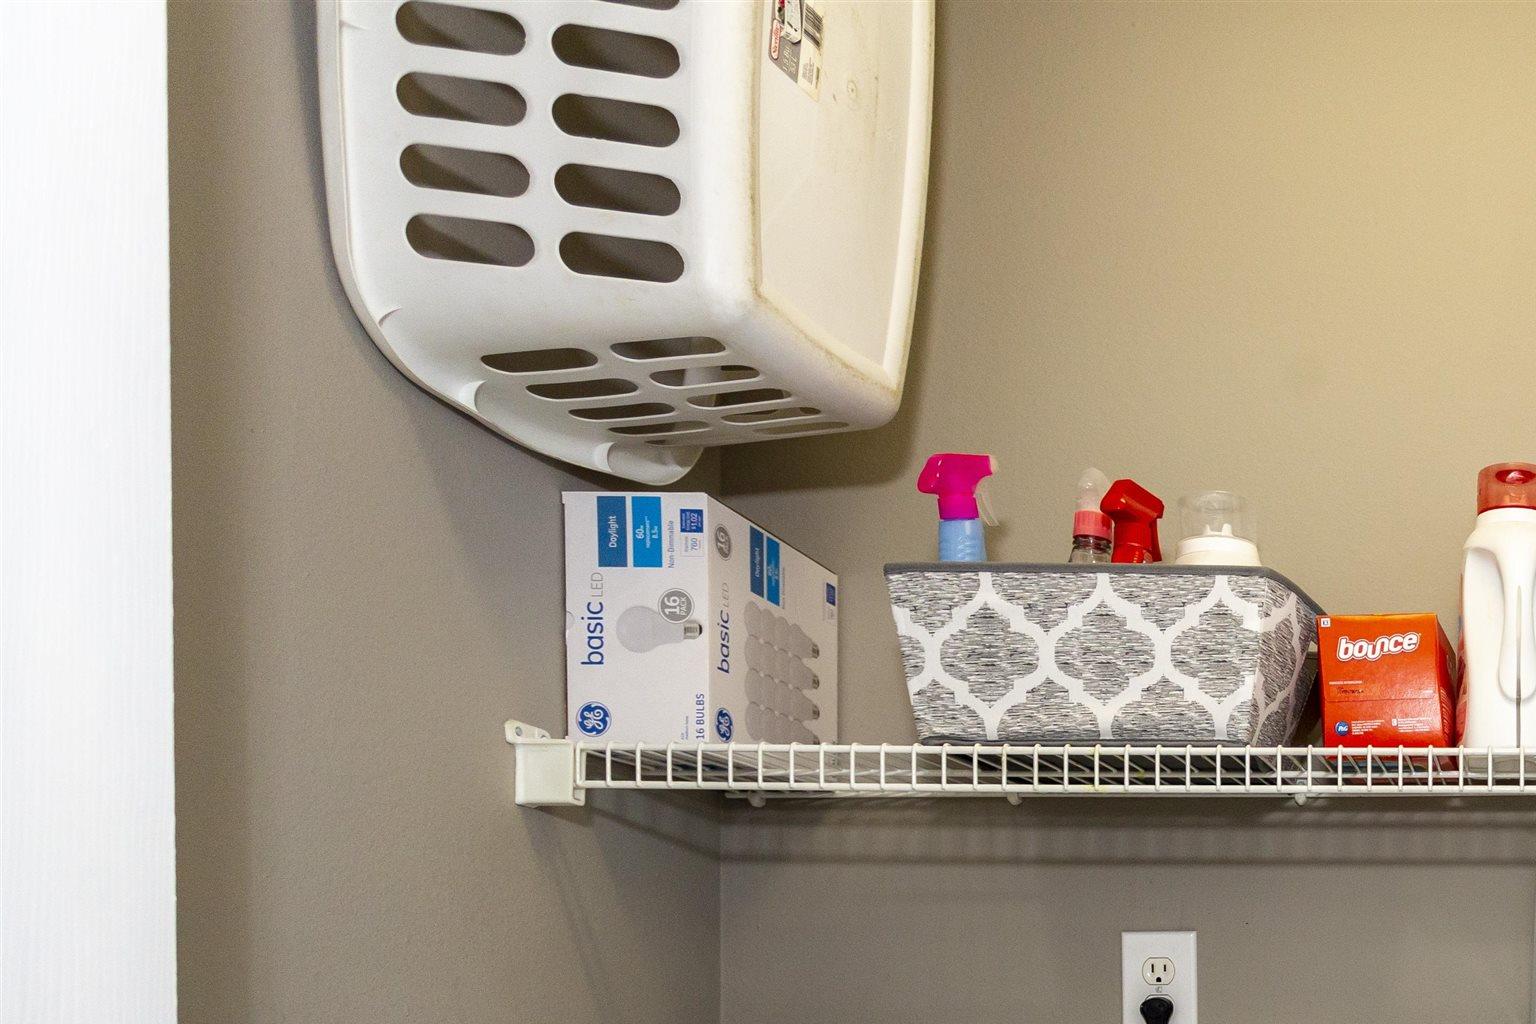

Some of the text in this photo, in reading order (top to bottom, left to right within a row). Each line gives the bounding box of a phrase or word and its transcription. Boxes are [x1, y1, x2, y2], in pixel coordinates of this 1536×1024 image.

[607, 515, 619, 548] Daylight
[667, 520, 675, 569] Non-Dimmable
[581, 572, 605, 666] basic LED
[664, 595, 680, 615] 16
[717, 582, 730, 675] basic LED
[1338, 632, 1420, 660] bounce
[695, 693, 705, 740] 16 BULBS
